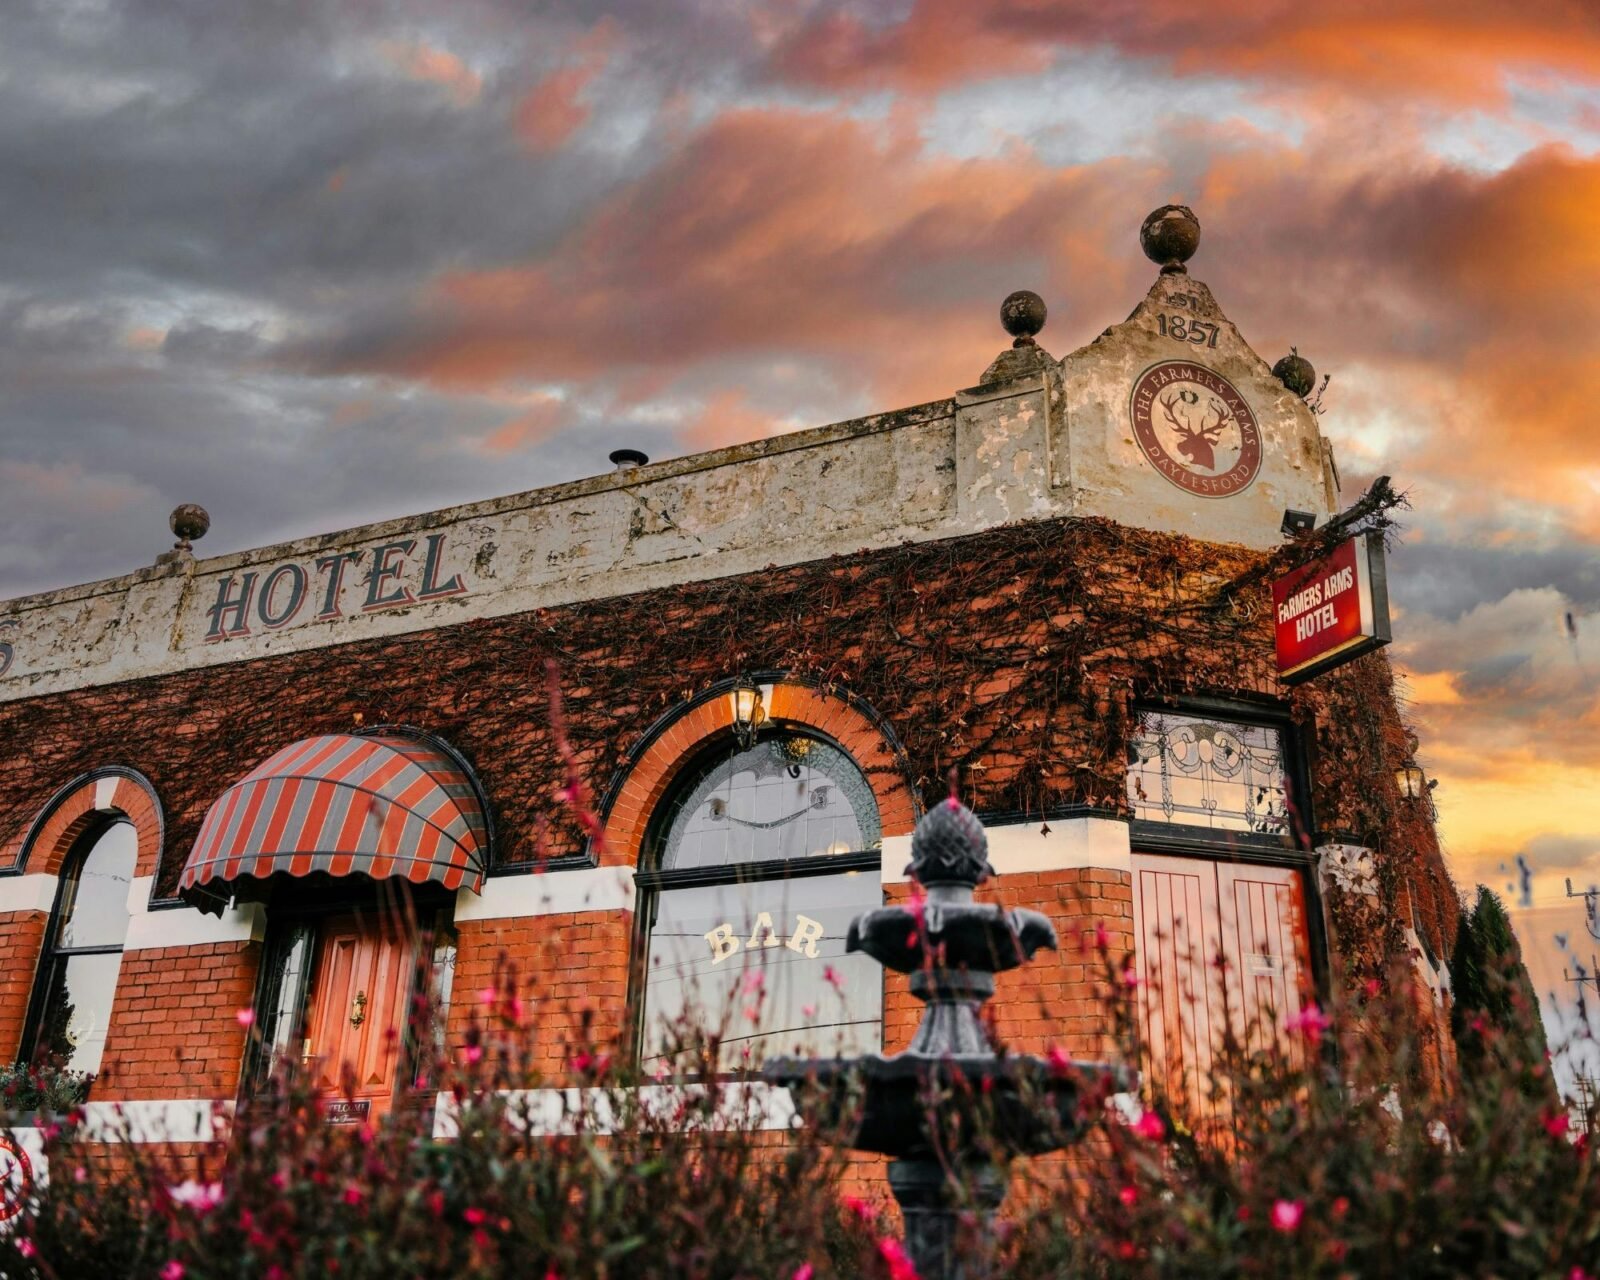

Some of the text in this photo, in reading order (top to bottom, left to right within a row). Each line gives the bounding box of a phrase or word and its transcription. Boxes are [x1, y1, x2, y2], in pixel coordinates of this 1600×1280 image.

[1157, 313, 1219, 349] 1857
[1137, 368, 1256, 446] THE FARMERS ARMS
[1148, 447, 1249, 492] DAYLESFORD
[205, 534, 467, 642] HOTEL
[1278, 566, 1354, 624] FARMERS ARMS
[1296, 602, 1338, 642] HOTEL
[704, 911, 824, 965] BAR
